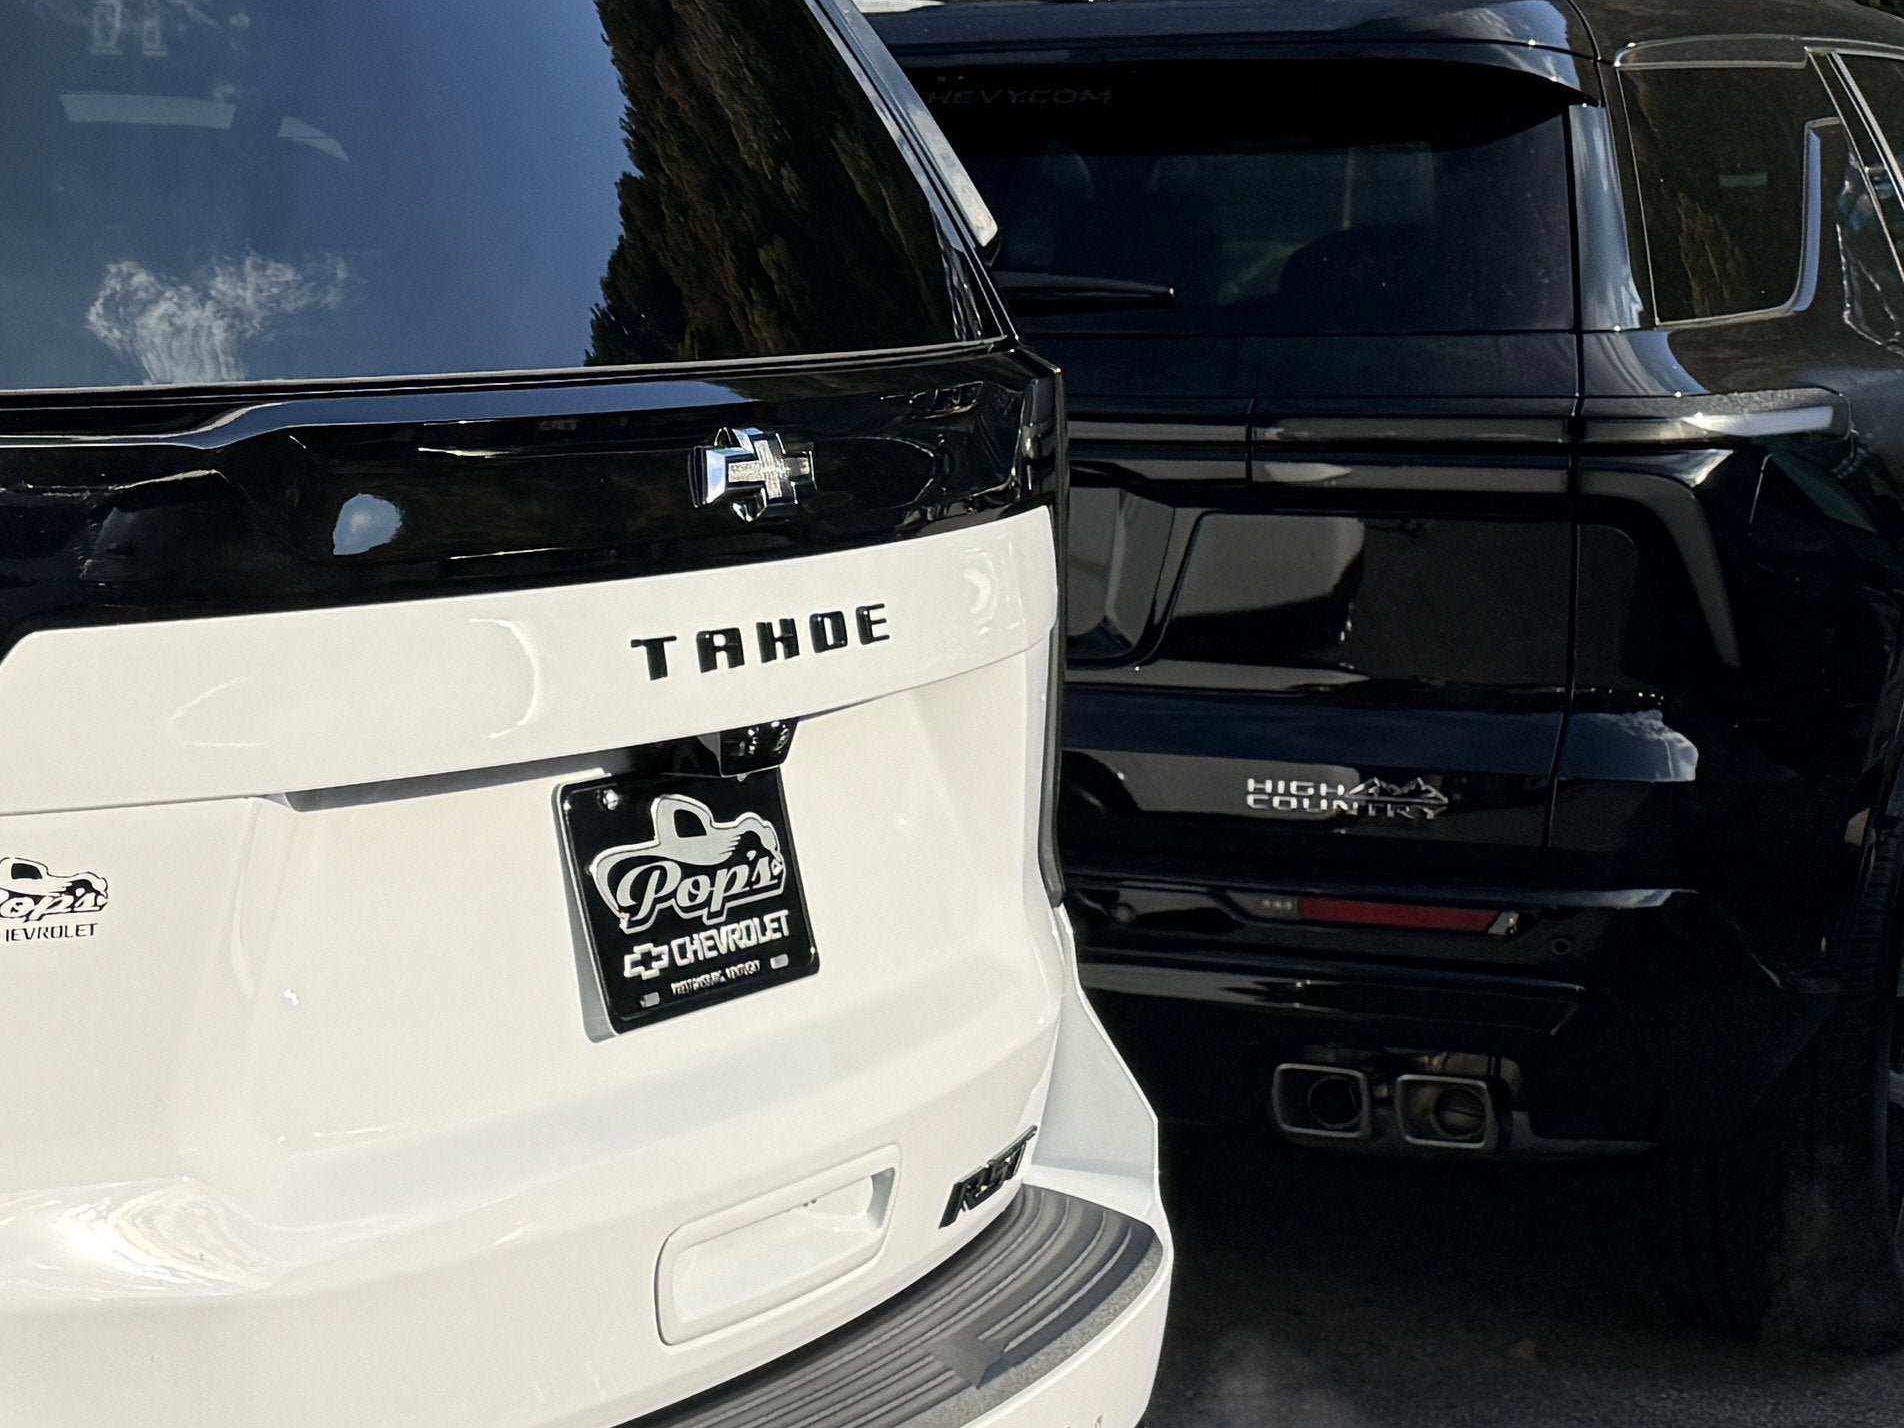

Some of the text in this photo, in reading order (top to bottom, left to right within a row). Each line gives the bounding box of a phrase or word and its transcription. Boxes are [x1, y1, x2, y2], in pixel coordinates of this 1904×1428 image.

[920, 86, 1113, 105] HEVY.COM
[630, 603, 891, 682] TAHOE
[1246, 777, 1345, 797] HIGH
[1246, 793, 1448, 820] COUNTRY
[616, 850, 779, 921] Pop's
[671, 908, 790, 967] CHEVROLET
[938, 1124, 1038, 1230] RST
